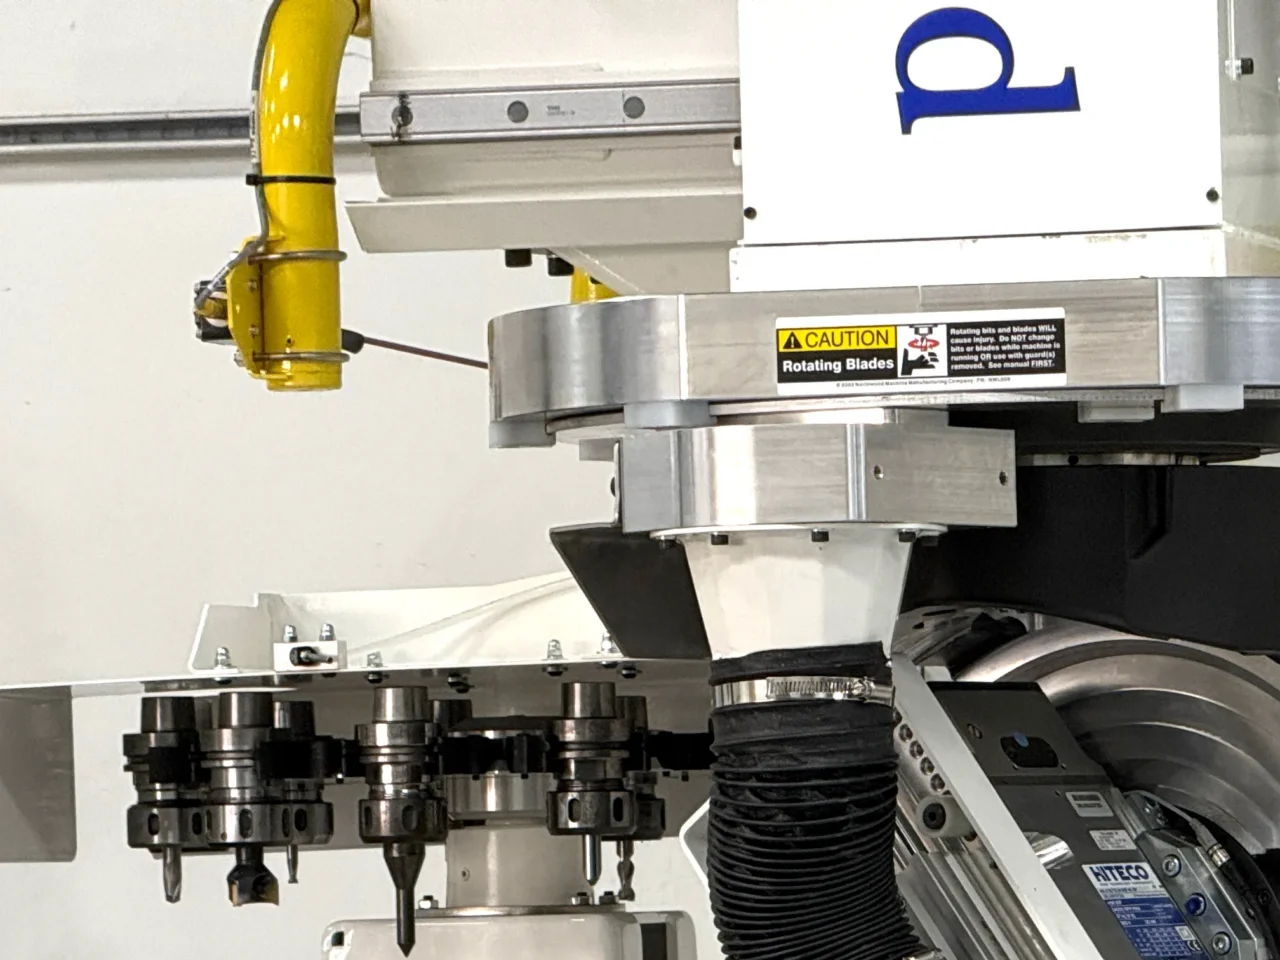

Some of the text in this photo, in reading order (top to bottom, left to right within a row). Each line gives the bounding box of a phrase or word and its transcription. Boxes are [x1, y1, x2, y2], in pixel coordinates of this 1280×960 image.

[1038, 324, 1057, 332] WILL
[805, 330, 889, 348] CAUTION
[973, 335, 996, 344] injury.
[1011, 334, 1027, 342] NOT
[1028, 333, 1055, 342] change
[975, 344, 1000, 352] blades
[1022, 342, 1052, 350] machine
[1053, 341, 1061, 349] is
[951, 354, 979, 362] running
[980, 353, 992, 361] OR
[1007, 351, 1023, 359] with
[1024, 350, 1056, 360] guard(s)
[783, 358, 894, 373] Rotating Blades
[950, 362, 985, 370] removed.
[988, 361, 1002, 369] See
[1003, 360, 1030, 368] manual
[1089, 865, 1149, 881] HITECO
